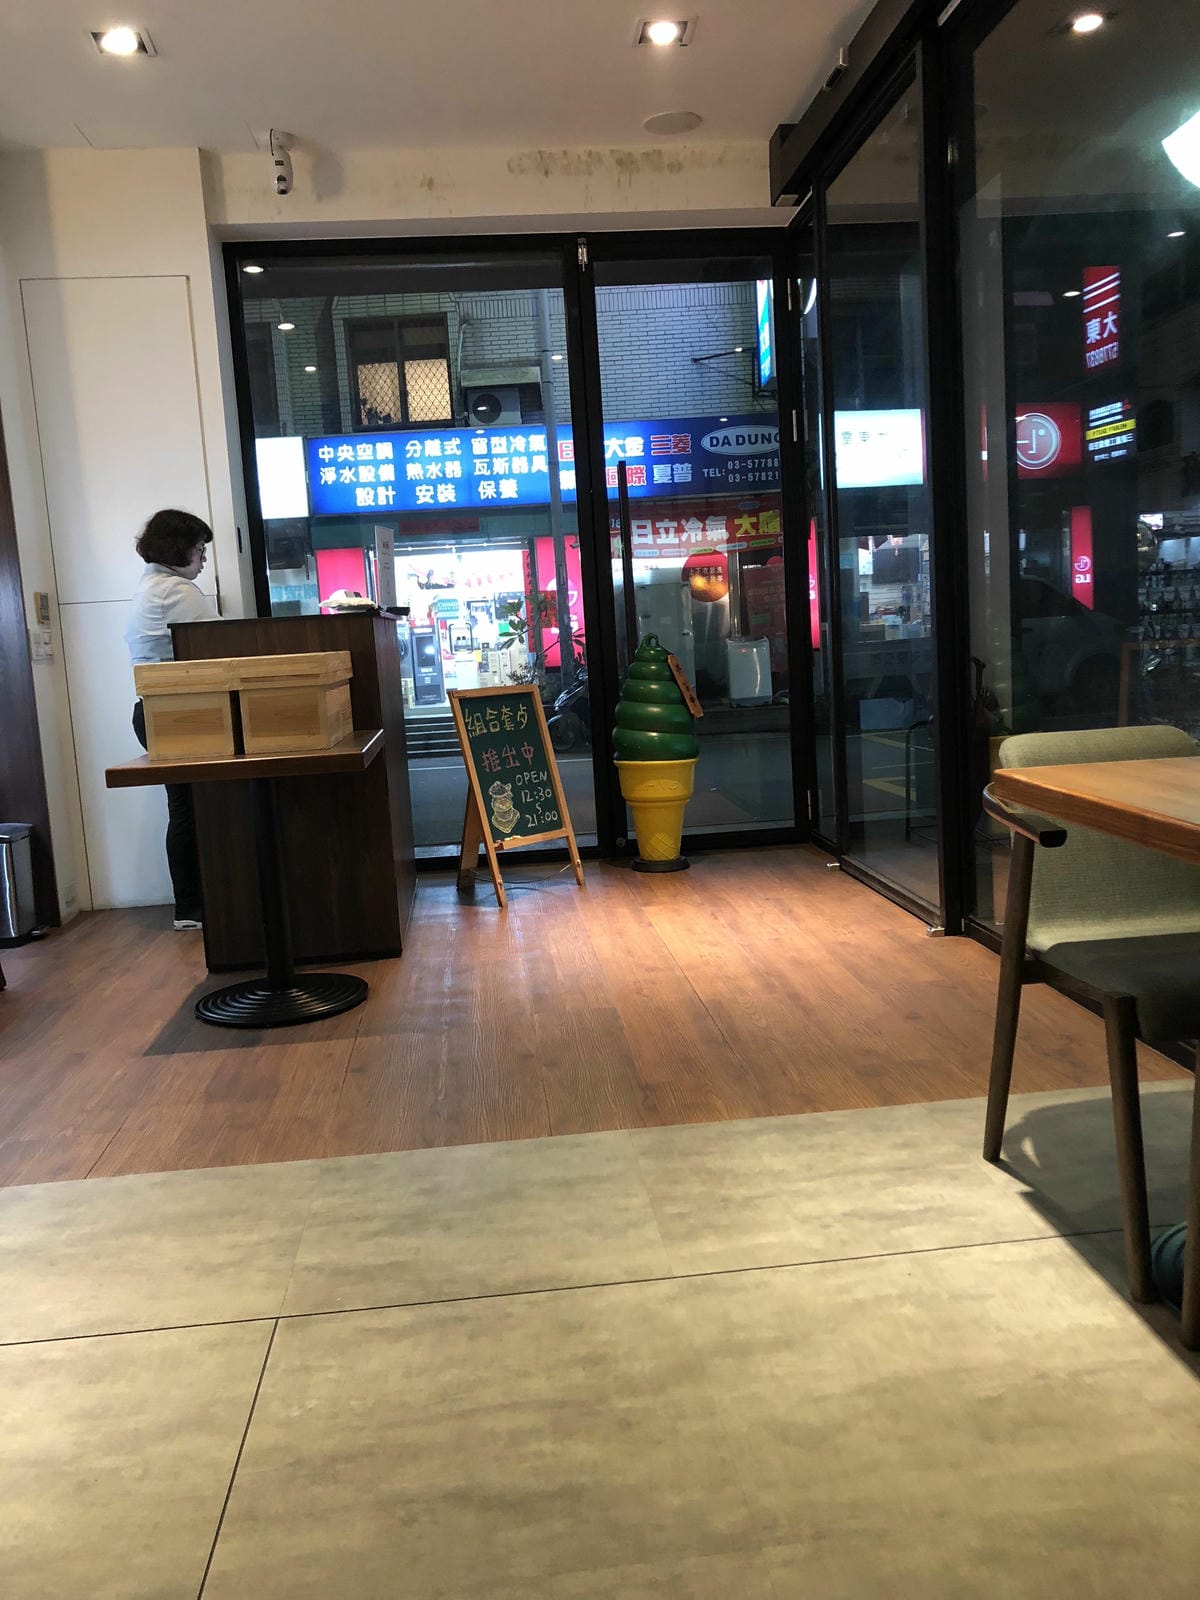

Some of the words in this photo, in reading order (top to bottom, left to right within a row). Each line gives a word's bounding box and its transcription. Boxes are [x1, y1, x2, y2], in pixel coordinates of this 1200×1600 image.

[318, 442, 393, 463] 中央空調
[405, 437, 462, 458] 分離式
[471, 434, 547, 455] 窗型冷氣
[604, 436, 645, 458] 大金
[650, 433, 692, 456] 三菱
[320, 464, 396, 485] 淨水設備
[406, 461, 462, 481] 熱水器
[473, 455, 548, 477] 瓦斯器具
[652, 463, 692, 484] 夏普
[702, 468, 726, 478] TEL:
[355, 486, 396, 507] 設計
[415, 484, 457, 505] 安裝
[478, 479, 518, 500] 保養
[631, 516, 729, 545] 日立冷氣
[481, 741, 535, 773] 推出中
[515, 770, 548, 786] OPEN
[521, 787, 552, 804] 12:30
[525, 810, 559, 828] 21:00
